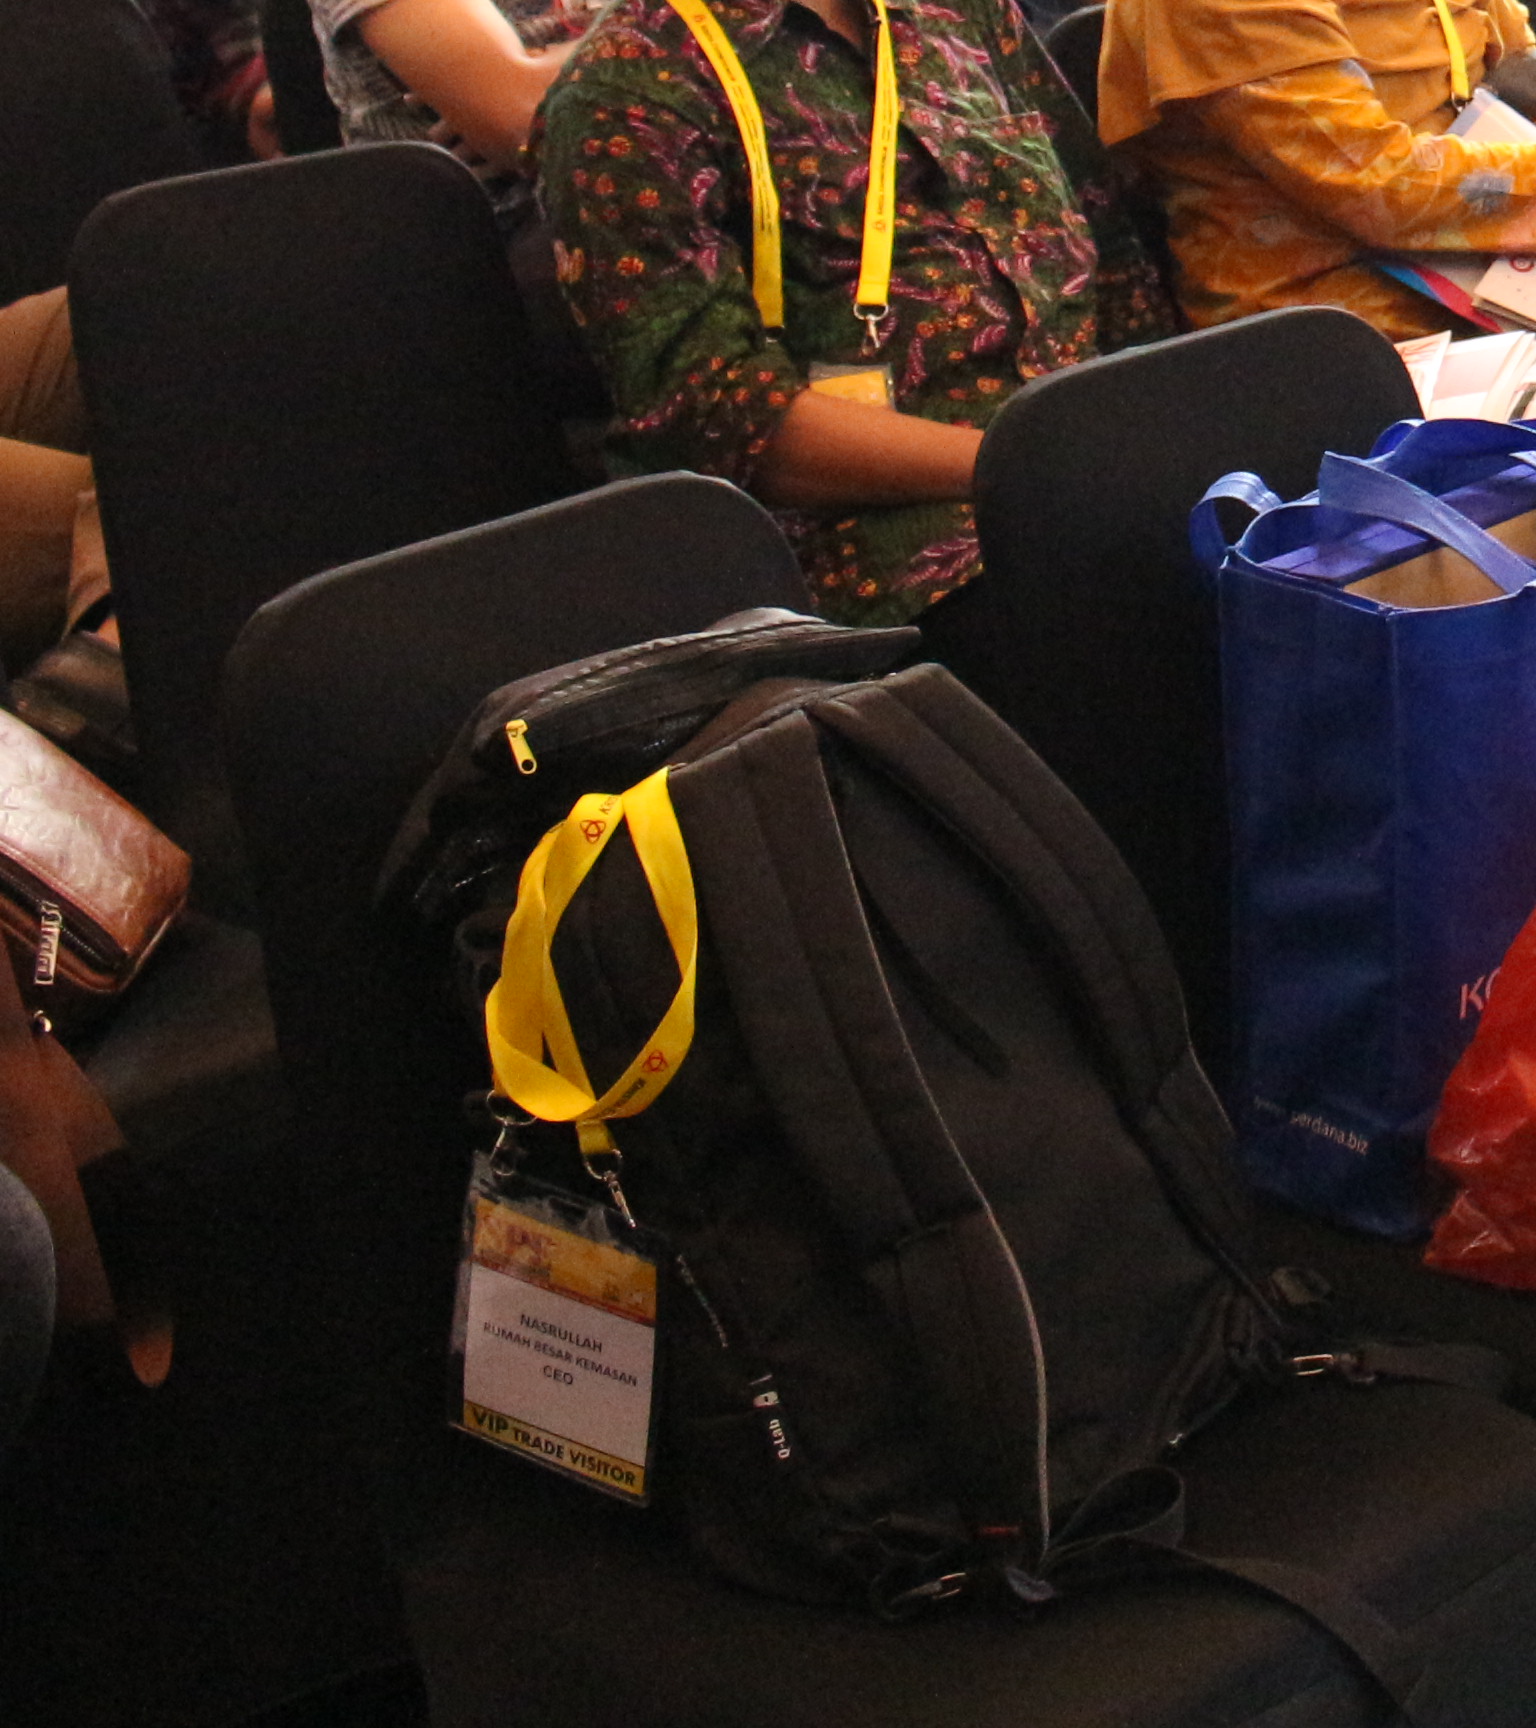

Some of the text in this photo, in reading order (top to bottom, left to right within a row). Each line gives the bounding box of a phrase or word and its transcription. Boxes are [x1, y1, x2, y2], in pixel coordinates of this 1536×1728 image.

[482, 1321, 639, 1388] RUMAH BESAR KEMASAN
[519, 1313, 604, 1354] NASRULLAH
[542, 1364, 575, 1387] CEO
[471, 1405, 639, 1488] VIP TRADE VISITOR
